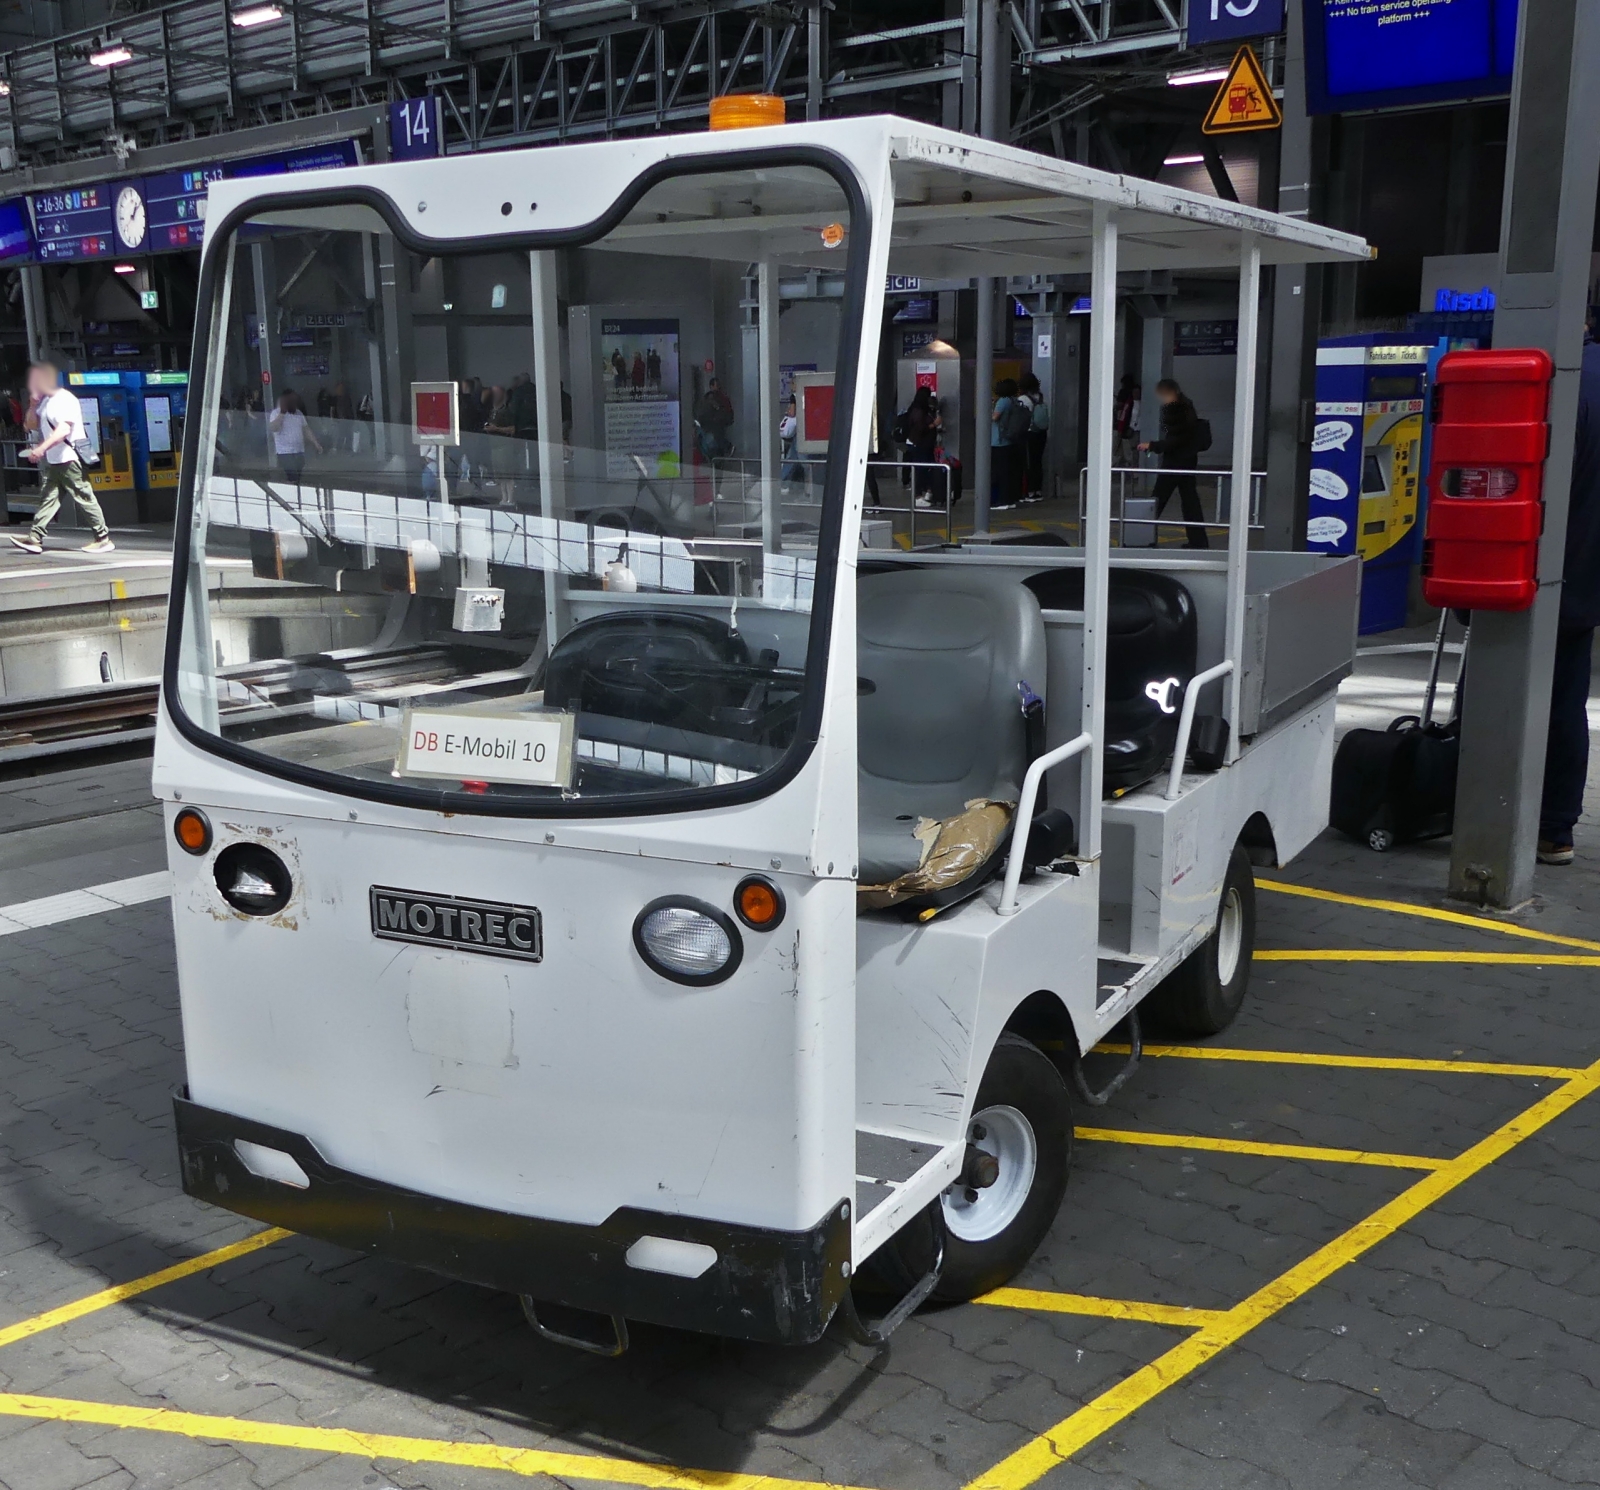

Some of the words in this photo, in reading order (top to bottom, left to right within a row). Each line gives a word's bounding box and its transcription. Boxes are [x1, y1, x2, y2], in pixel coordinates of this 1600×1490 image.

[1347, 8, 1359, 16] No
[1360, 5, 1379, 14] train
[1380, 1, 1410, 12] service
[1412, 0, 1452, 8] operag
[1378, 12, 1412, 27] platform
[400, 100, 430, 147] 14
[43, 196, 64, 213] 16-36
[308, 316, 344, 325] ZECH
[912, 333, 934, 344] 16-36
[413, 731, 438, 752] DB
[444, 734, 517, 760] E-Mobil
[522, 742, 546, 763] 10
[379, 898, 532, 949] MOTREC
